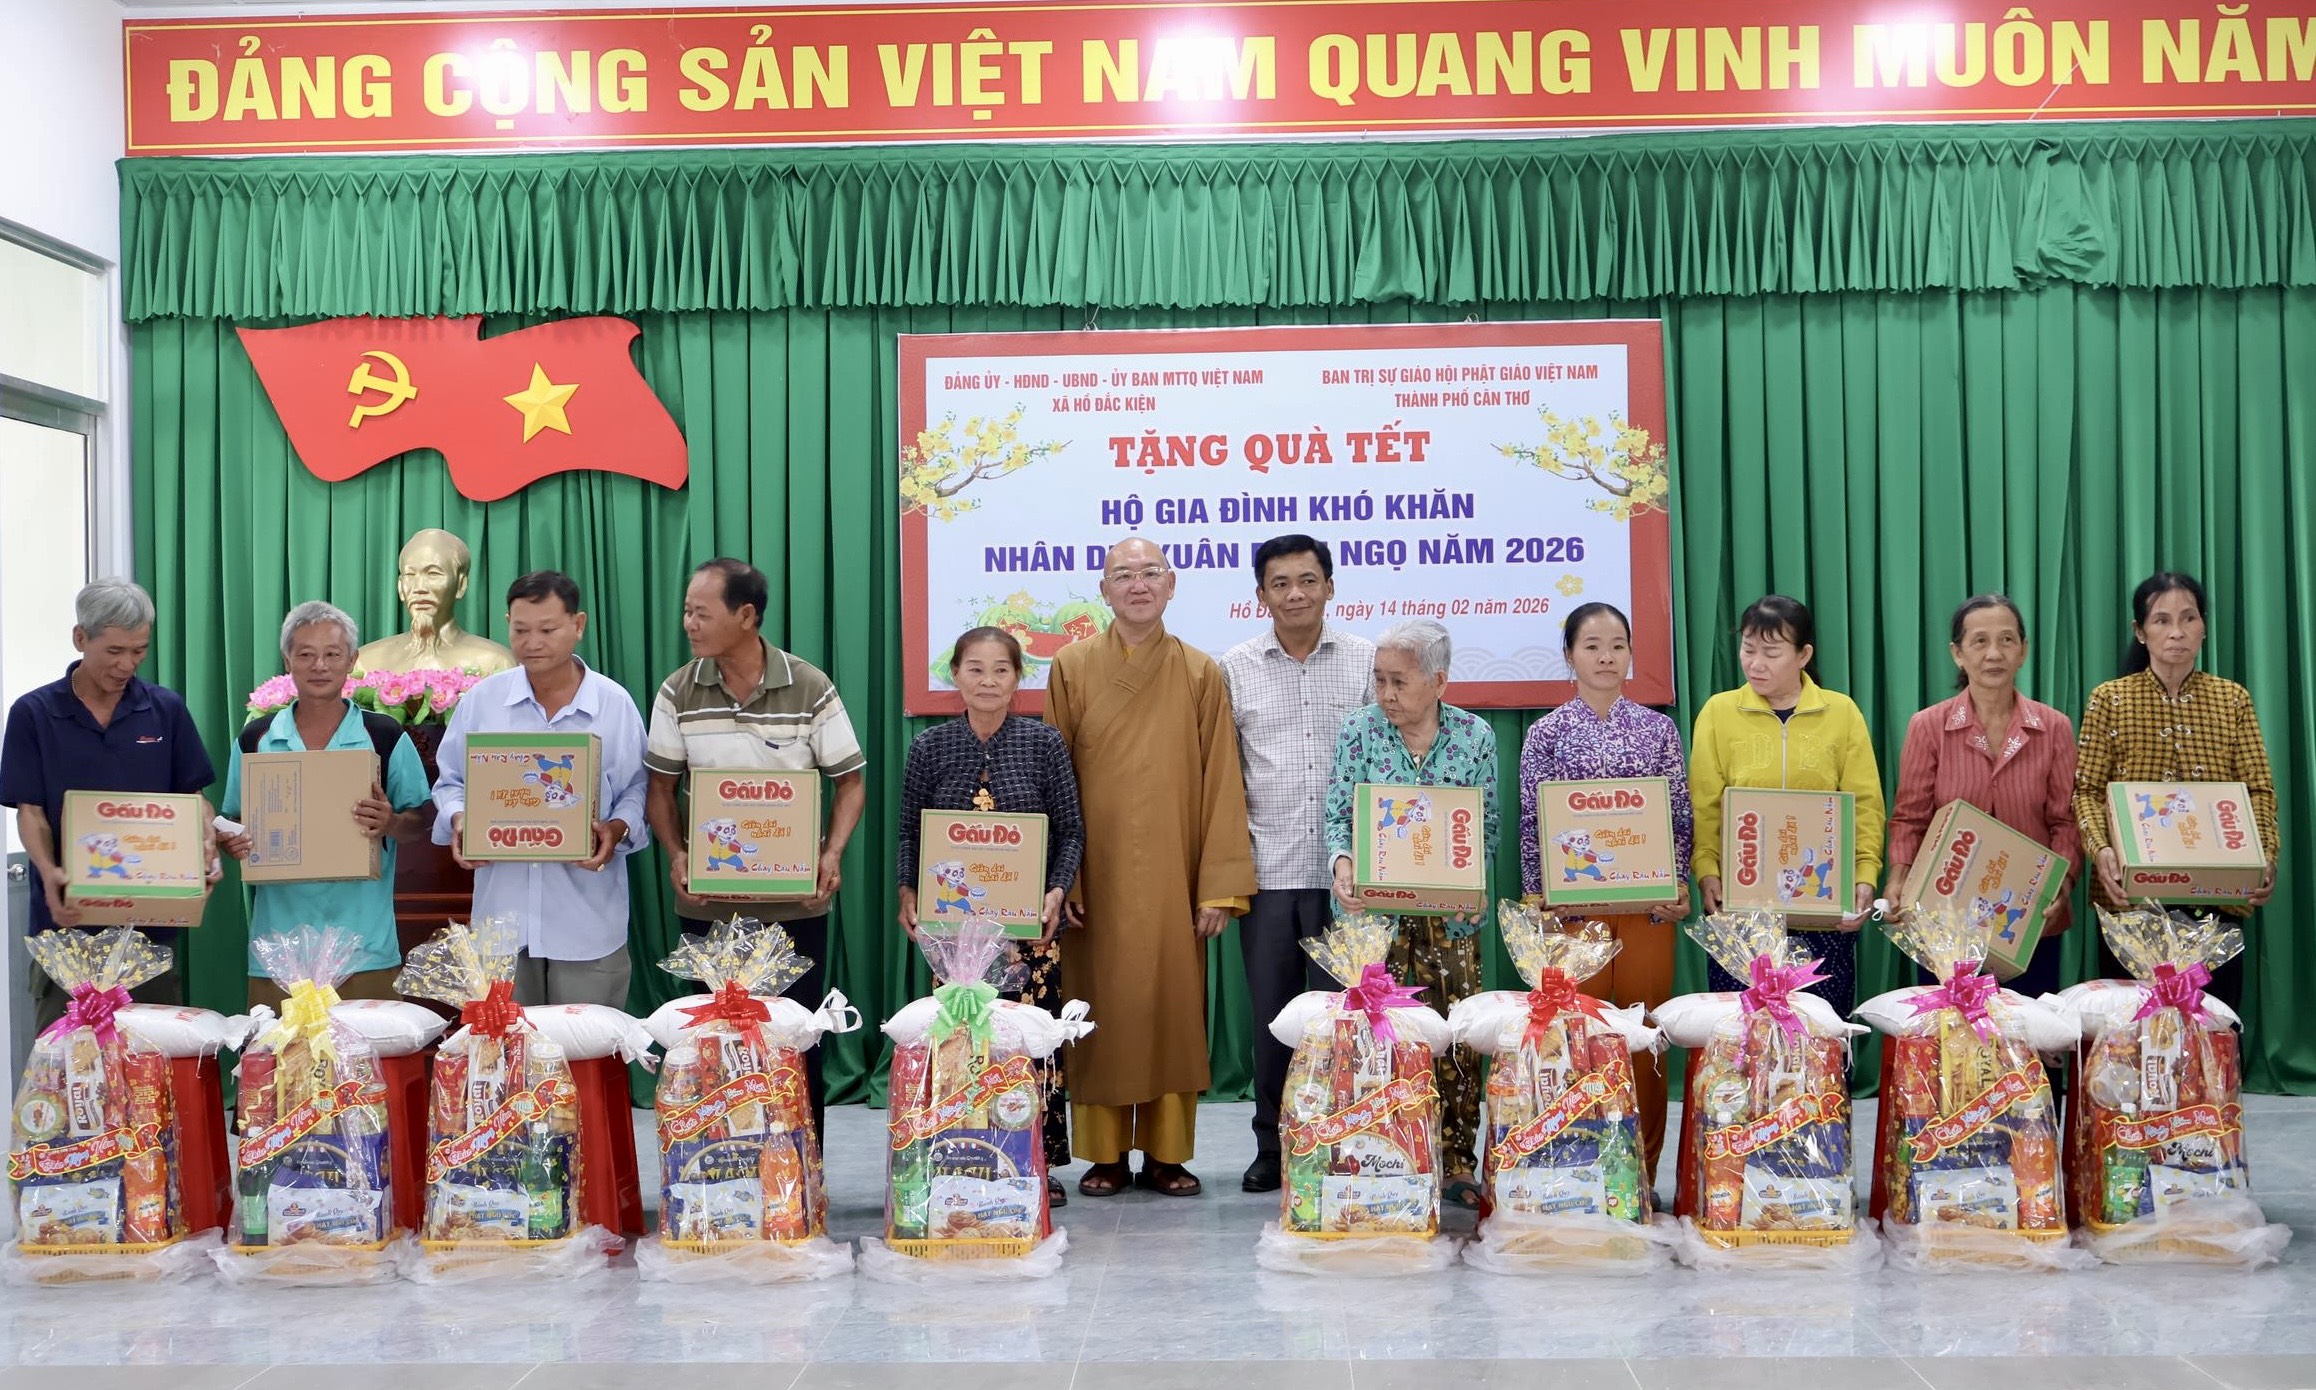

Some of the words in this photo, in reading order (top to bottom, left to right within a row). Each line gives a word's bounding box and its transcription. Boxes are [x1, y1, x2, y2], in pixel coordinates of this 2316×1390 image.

[166, 36, 392, 122] ĐẢNG
[423, 38, 648, 130] CỘNG
[679, 24, 849, 112] SẢN
[878, 28, 1053, 121] VIỆT
[1083, 36, 1276, 104] NAM
[1308, 29, 1591, 107] QUANG
[1620, 25, 1820, 93] VINH
[1853, 7, 2110, 88] MUÔN
[944, 371, 981, 390] ĐẢNG
[984, 370, 1001, 389] ỦY
[1062, 373, 1098, 388] UBND
[1111, 368, 1127, 388] ỦY
[1131, 373, 1159, 387] BAN
[1162, 371, 1197, 388] MTTQ
[1201, 368, 1230, 388] VIỆT
[1233, 370, 1264, 385] NAM
[1322, 369, 1350, 384] BAN
[1353, 369, 1375, 387] TRỊ
[1378, 367, 1398, 386] SỰ
[1400, 365, 1431, 383] GIÁO
[1435, 364, 1458, 385] HỘI
[1462, 364, 1496, 384] PHẬT
[1500, 363, 1531, 381] GIÁO
[1535, 362, 1563, 383] VIỆT
[1567, 364, 1598, 380] NAM
[1052, 395, 1070, 412] XÃ
[1095, 392, 1121, 412] ĐẮC
[1125, 394, 1156, 414] KIỆN
[1394, 390, 1438, 407] THÀNH
[1442, 387, 1469, 407] PHỐ
[1505, 389, 1531, 406] THƠ
[1109, 429, 1229, 475] TẶNG
[1244, 426, 1333, 474] QUÀ
[1347, 420, 1430, 463] TẾT
[1101, 494, 1143, 531] HỘ
[1155, 497, 1209, 525] GIA
[1219, 491, 1297, 523] ĐÌNH
[1309, 489, 1374, 522] KHÓ
[1385, 488, 1475, 520] KHĂN
[985, 540, 1075, 573] NHÂN
[1340, 539, 1407, 570] NGỌ
[1419, 534, 1494, 565] NĂM
[1506, 537, 1585, 564] 2026
[1230, 600, 1251, 619] Hồ
[1336, 602, 1375, 621] ngày
[1380, 601, 1397, 617] 14
[1402, 599, 1446, 620] tháng
[1451, 600, 1469, 616] 02
[1474, 599, 1507, 615] năm
[1513, 598, 1549, 615] 2026
[718, 780, 763, 799] Gấu
[764, 780, 793, 800] Đỏ
[1567, 790, 1613, 811] Gấu
[1614, 788, 1644, 809] Đỏ
[98, 802, 143, 818] Gấu
[146, 803, 175, 819] Đỏ
[2216, 800, 2241, 833] Gấu
[488, 827, 517, 847] Đỏ
[518, 826, 562, 847] Gấu
[948, 823, 991, 843] Gấu
[992, 824, 1021, 844] Đỏ
[1450, 808, 1471, 844] Gấu
[1737, 812, 1757, 841] Đỏ
[2223, 830, 2247, 850] Đỏ
[750, 863, 771, 873] Chay
[774, 863, 789, 871] Rau
[1451, 845, 1472, 869] Đỏ
[1737, 841, 1757, 885] Gấu
[1935, 860, 1966, 896] Gấu
[1951, 830, 1976, 858] Đỏ
[978, 907, 998, 917] Chay
[1001, 908, 1016, 916] Rau
[1361, 1154, 1405, 1171] Mochi
